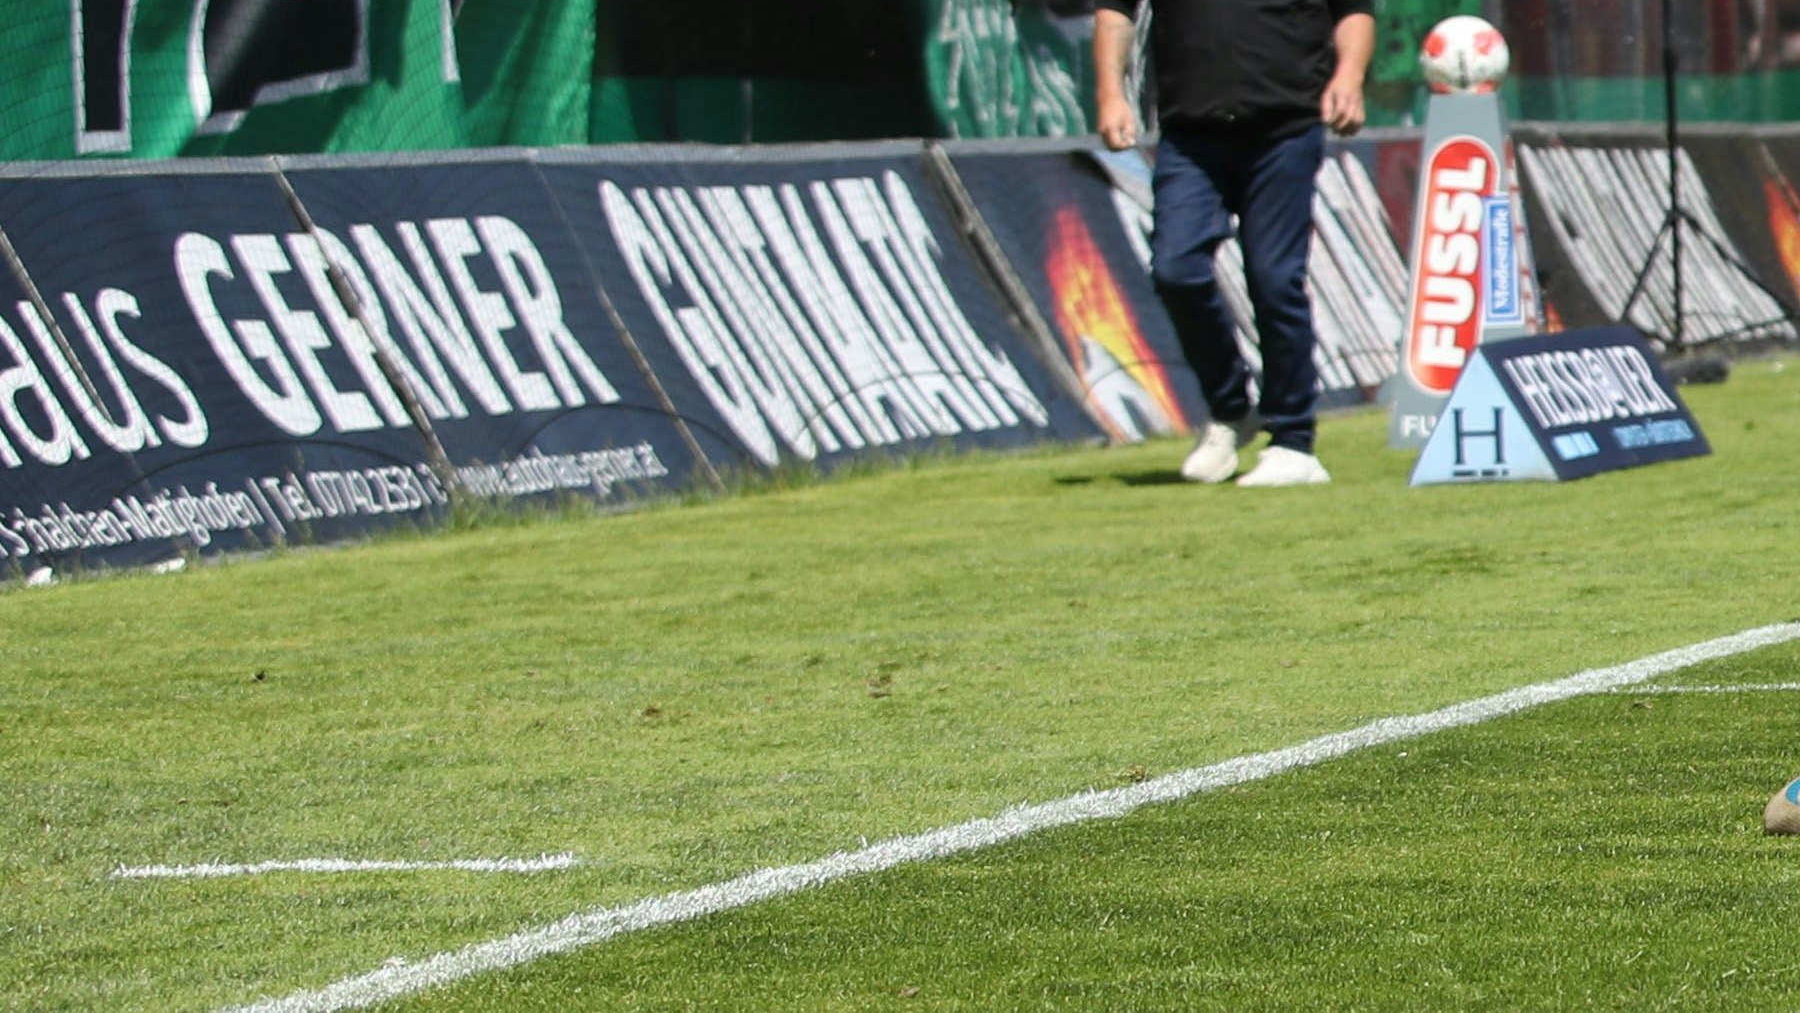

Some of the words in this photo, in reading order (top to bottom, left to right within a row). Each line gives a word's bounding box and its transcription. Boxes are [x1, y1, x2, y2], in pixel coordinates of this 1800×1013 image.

[175, 215, 622, 438] GERNER
[1417, 156, 1489, 368] FUSSL
[1452, 405, 1508, 465] H
